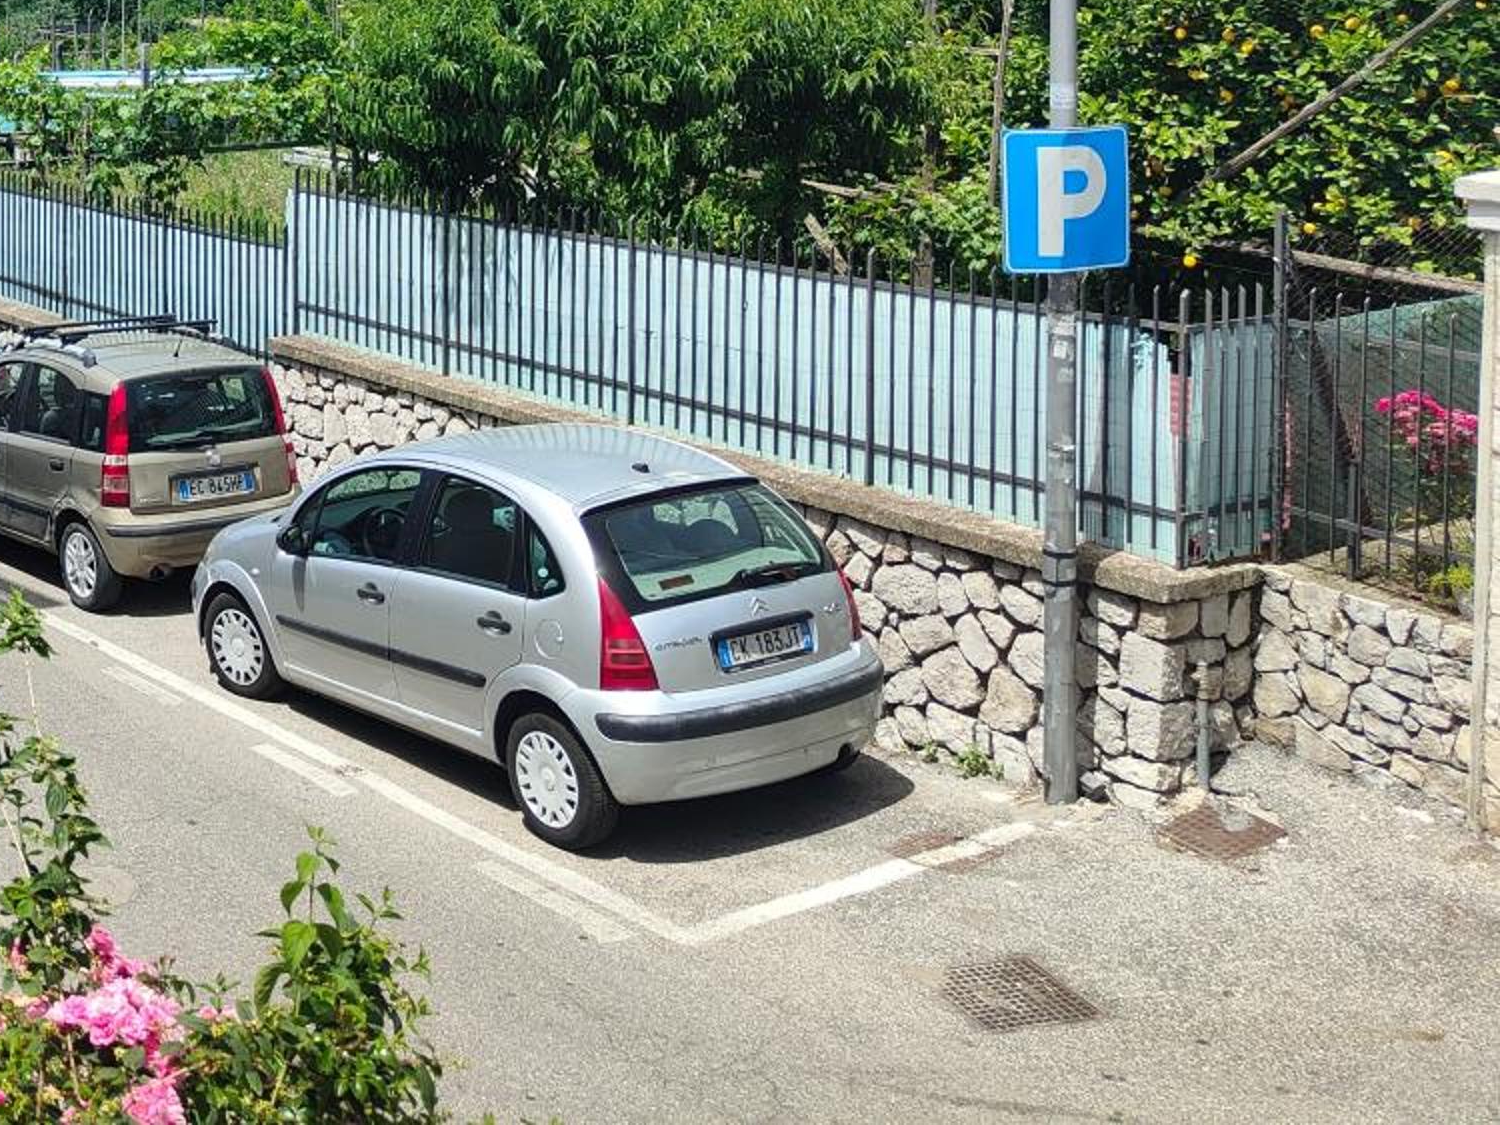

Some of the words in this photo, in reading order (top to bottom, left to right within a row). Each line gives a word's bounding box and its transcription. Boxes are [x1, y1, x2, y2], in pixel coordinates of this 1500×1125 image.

[1037, 144, 1107, 257] P
[731, 635, 750, 661] CK
[756, 626, 801, 655] 183JT
